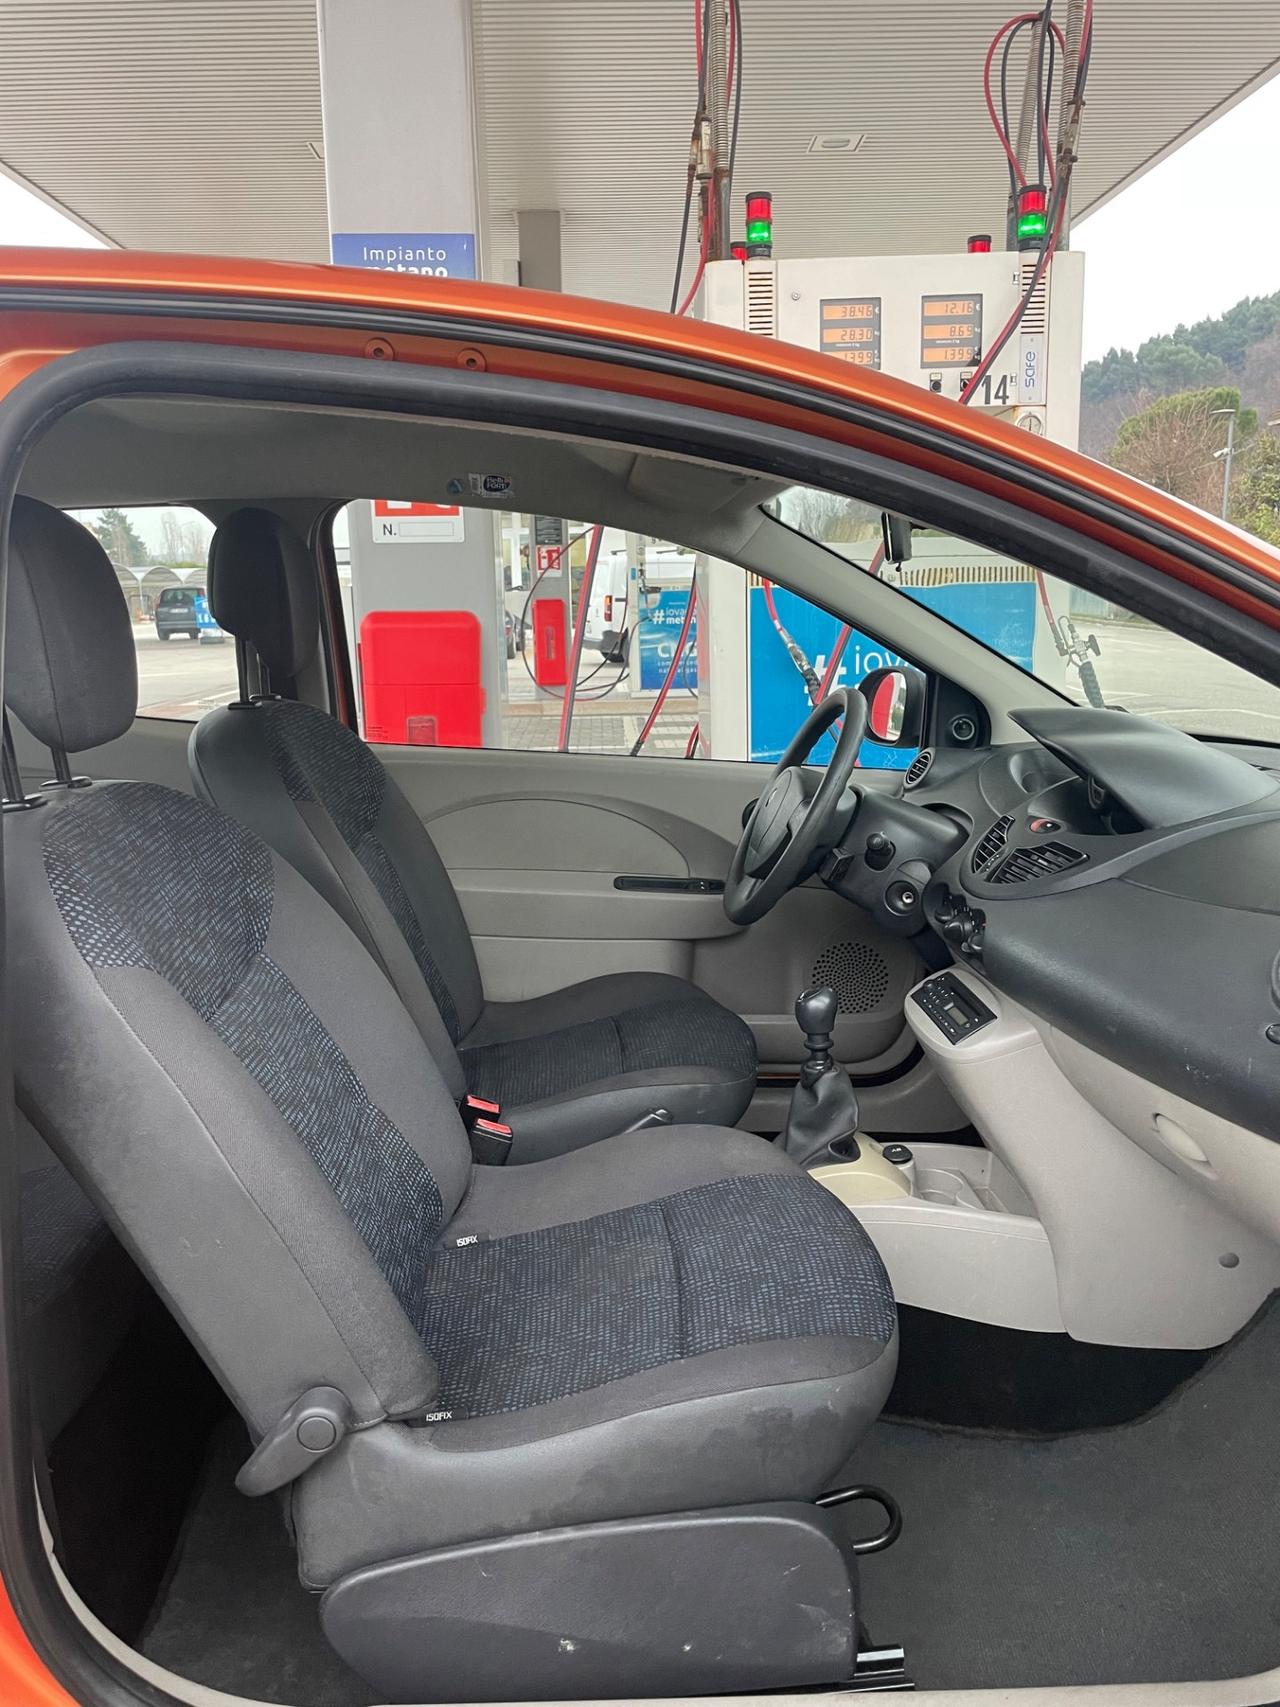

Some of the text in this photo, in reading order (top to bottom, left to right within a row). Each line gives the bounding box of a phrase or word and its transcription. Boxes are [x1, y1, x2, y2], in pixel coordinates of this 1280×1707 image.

[363, 246, 446, 263] Impianto
[365, 264, 448, 277] tano
[1025, 351, 1036, 387] safe
[981, 374, 1009, 404] 14
[383, 523, 397, 536] N.
[456, 1234, 478, 1247] ISOFIX
[426, 1411, 453, 1422] ISOFIX
